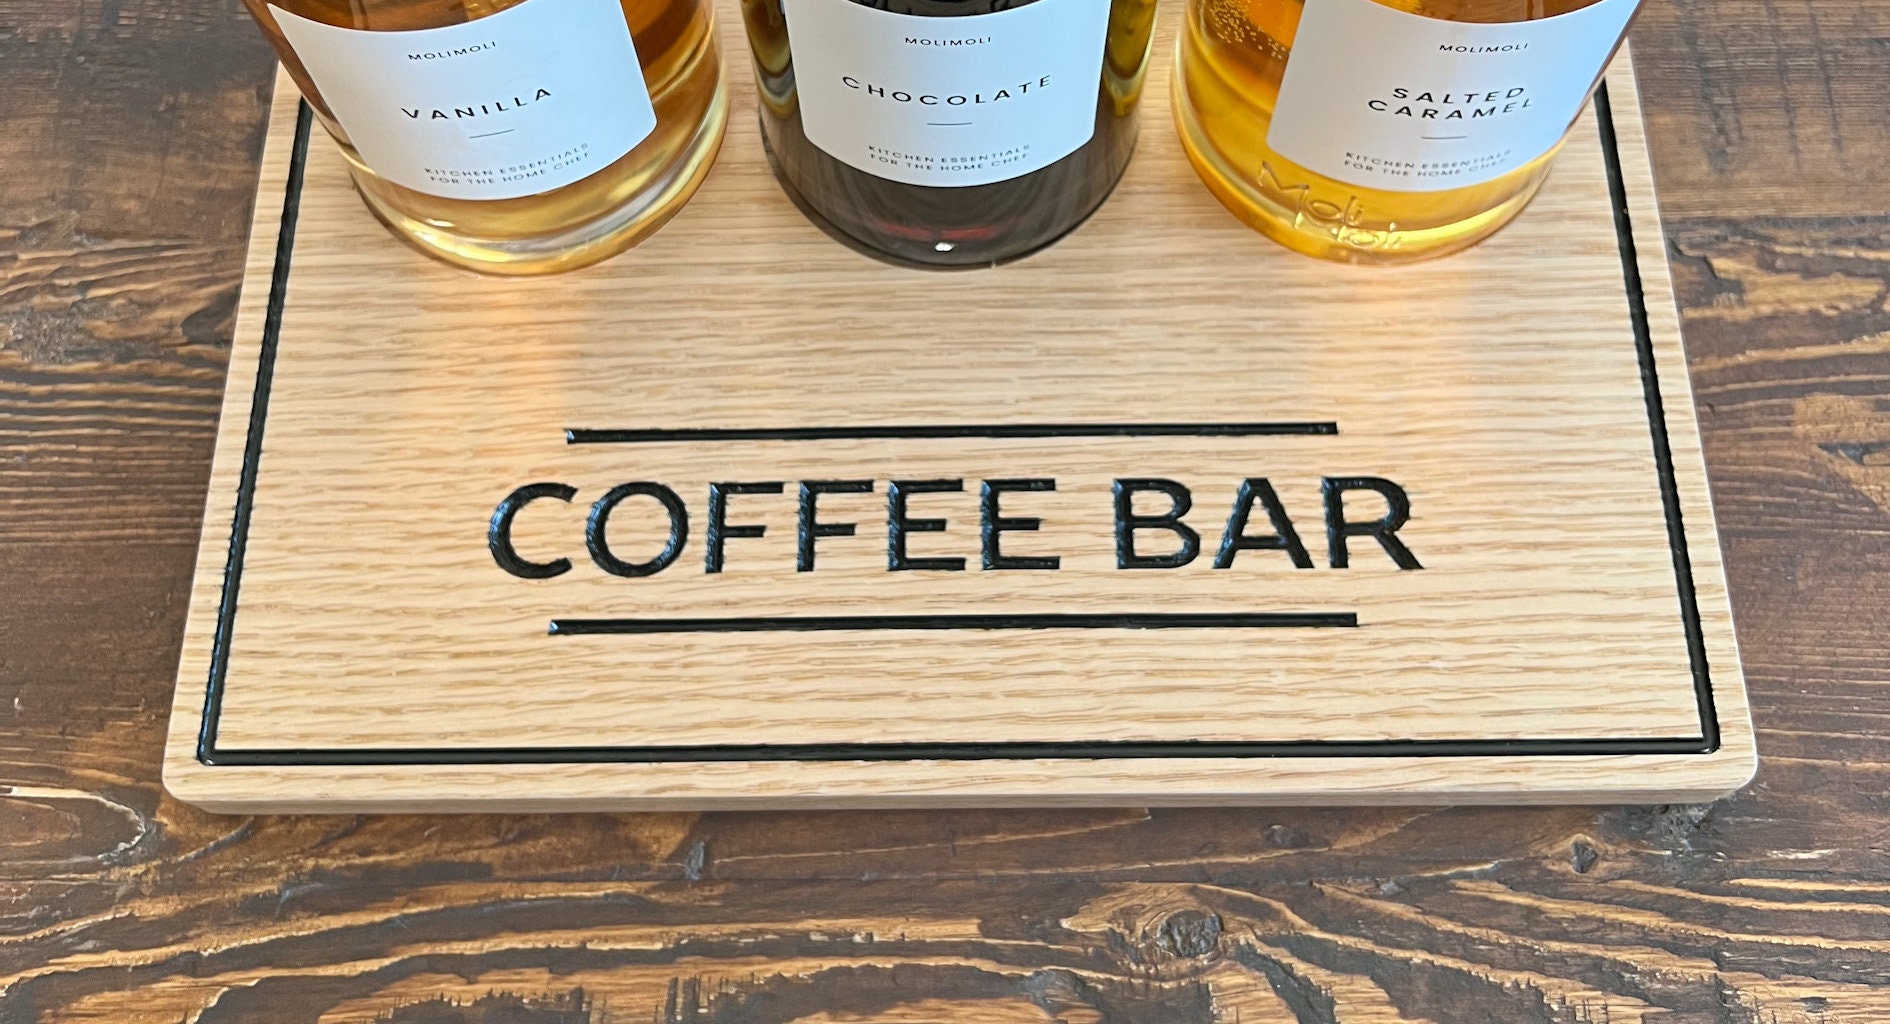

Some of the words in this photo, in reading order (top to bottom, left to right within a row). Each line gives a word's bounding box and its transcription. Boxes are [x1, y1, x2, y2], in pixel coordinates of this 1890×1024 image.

[408, 41, 497, 61] MOLIMOLI
[904, 36, 992, 47] MOLIMOLI
[1439, 42, 1529, 54] MOLIMOLI
[841, 74, 1053, 107] CHOCOLATE
[1392, 86, 1525, 105] SALTED
[400, 87, 552, 121] VANILLA
[1367, 97, 1533, 120] CARAMEL
[425, 167, 493, 177] KITCHEN
[500, 142, 588, 174] ESSENTIALS
[868, 145, 934, 163] KITCHEN
[941, 144, 1030, 163] ESSENTIALS
[870, 153, 898, 166] FOR
[906, 162, 932, 171] THE
[940, 163, 984, 171] HOME
[991, 153, 1028, 167] CHEF
[1346, 152, 1415, 169] KITCHEN
[1421, 149, 1511, 169] ESSENTIALS
[431, 176, 460, 185] FOR
[502, 169, 547, 183] HOME
[553, 151, 590, 170] CHEF
[1344, 160, 1374, 172] FOR
[1383, 168, 1409, 176] THE
[1417, 169, 1461, 177] HOME
[487, 477, 1062, 577] COFFEE
[1110, 476, 1426, 571] BAR
